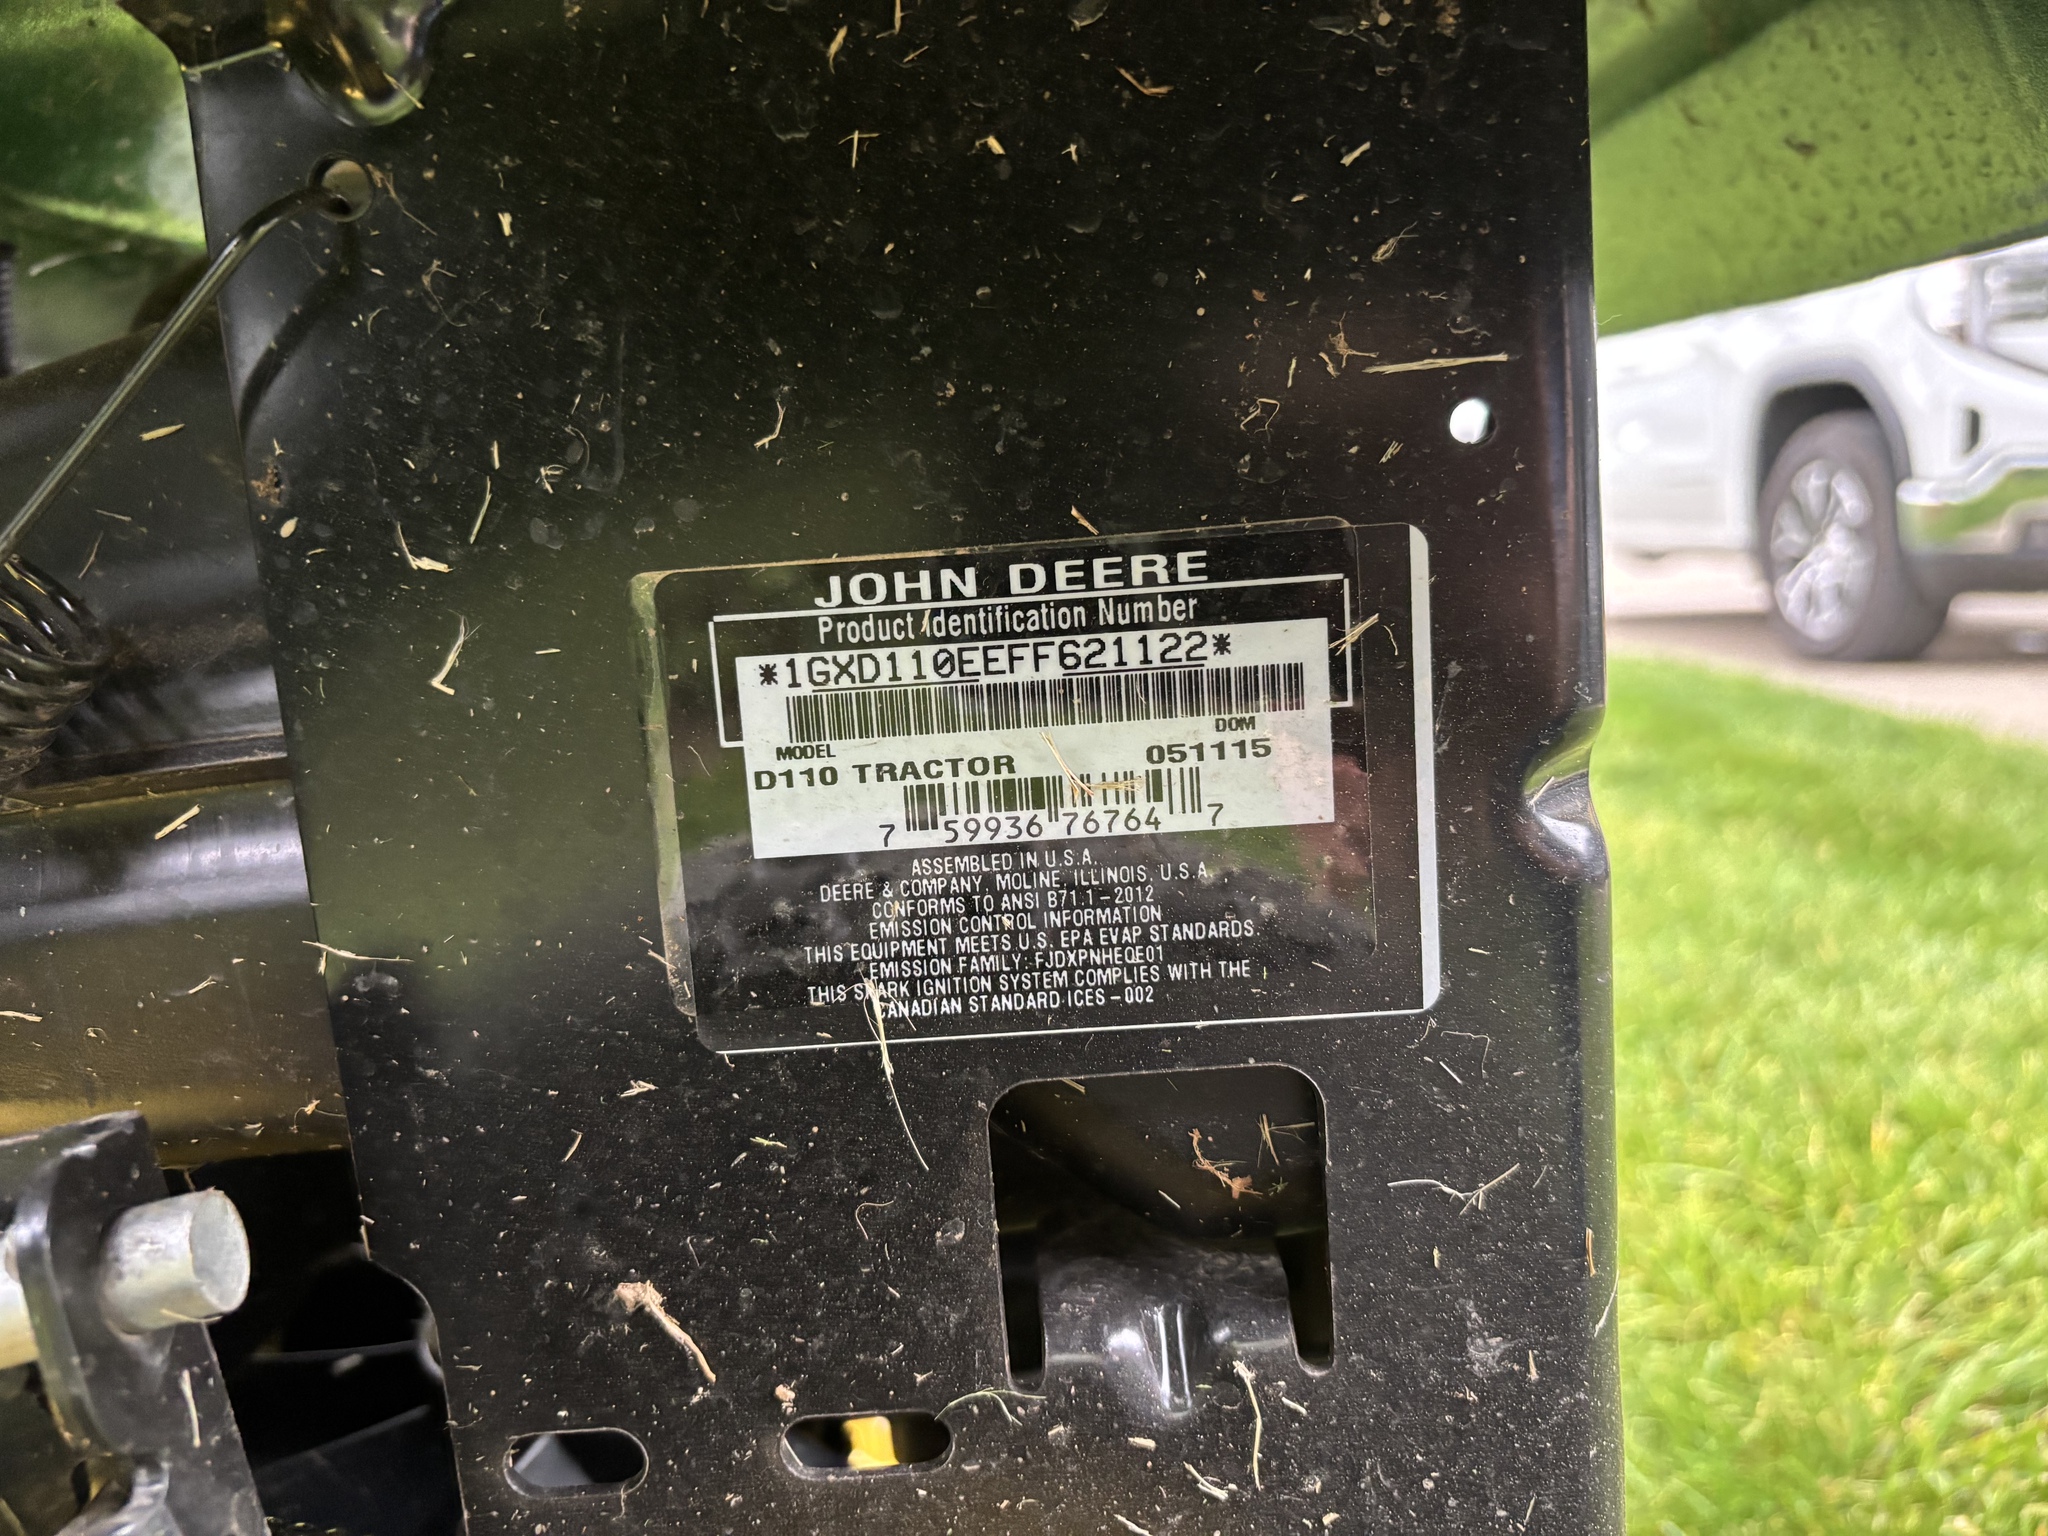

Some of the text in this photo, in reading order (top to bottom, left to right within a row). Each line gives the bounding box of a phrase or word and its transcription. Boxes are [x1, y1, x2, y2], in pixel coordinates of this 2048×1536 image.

[814, 550, 1208, 608] JOHN DEERE
[818, 594, 1198, 644] Product Identification Number
[1215, 716, 1256, 732] DOM
[776, 744, 836, 761] MODEL
[1146, 738, 1271, 764] 051115
[754, 754, 1016, 790] D110 TRACTOR
[879, 803, 1224, 847] 7 59936 76764 7
[911, 848, 1097, 876] ASSEMBLED IN U.S.A.
[820, 882, 874, 902] DEERE
[883, 881, 893, 898] &
[872, 896, 965, 919] CONFORMS
[973, 895, 994, 913] TO
[1001, 892, 1040, 911] ANSI
[869, 904, 1162, 940] EMISSION CONTROL INFORMATION
[804, 919, 1260, 964] THIS EQUIPMENT MEETS U.S. EPA EVAP STANDARDS.
[869, 959, 952, 980] EMISSION
[959, 953, 1028, 974] FAMILY:
[808, 984, 847, 1004] THIS
[917, 975, 992, 997] IGNITION
[1000, 970, 1068, 993] SYSTEM
[1074, 965, 1160, 987] COMPLIES
[1168, 963, 1211, 981] WITH
[1219, 959, 1250, 978] THE
[969, 989, 1060, 1013] STANDARD
